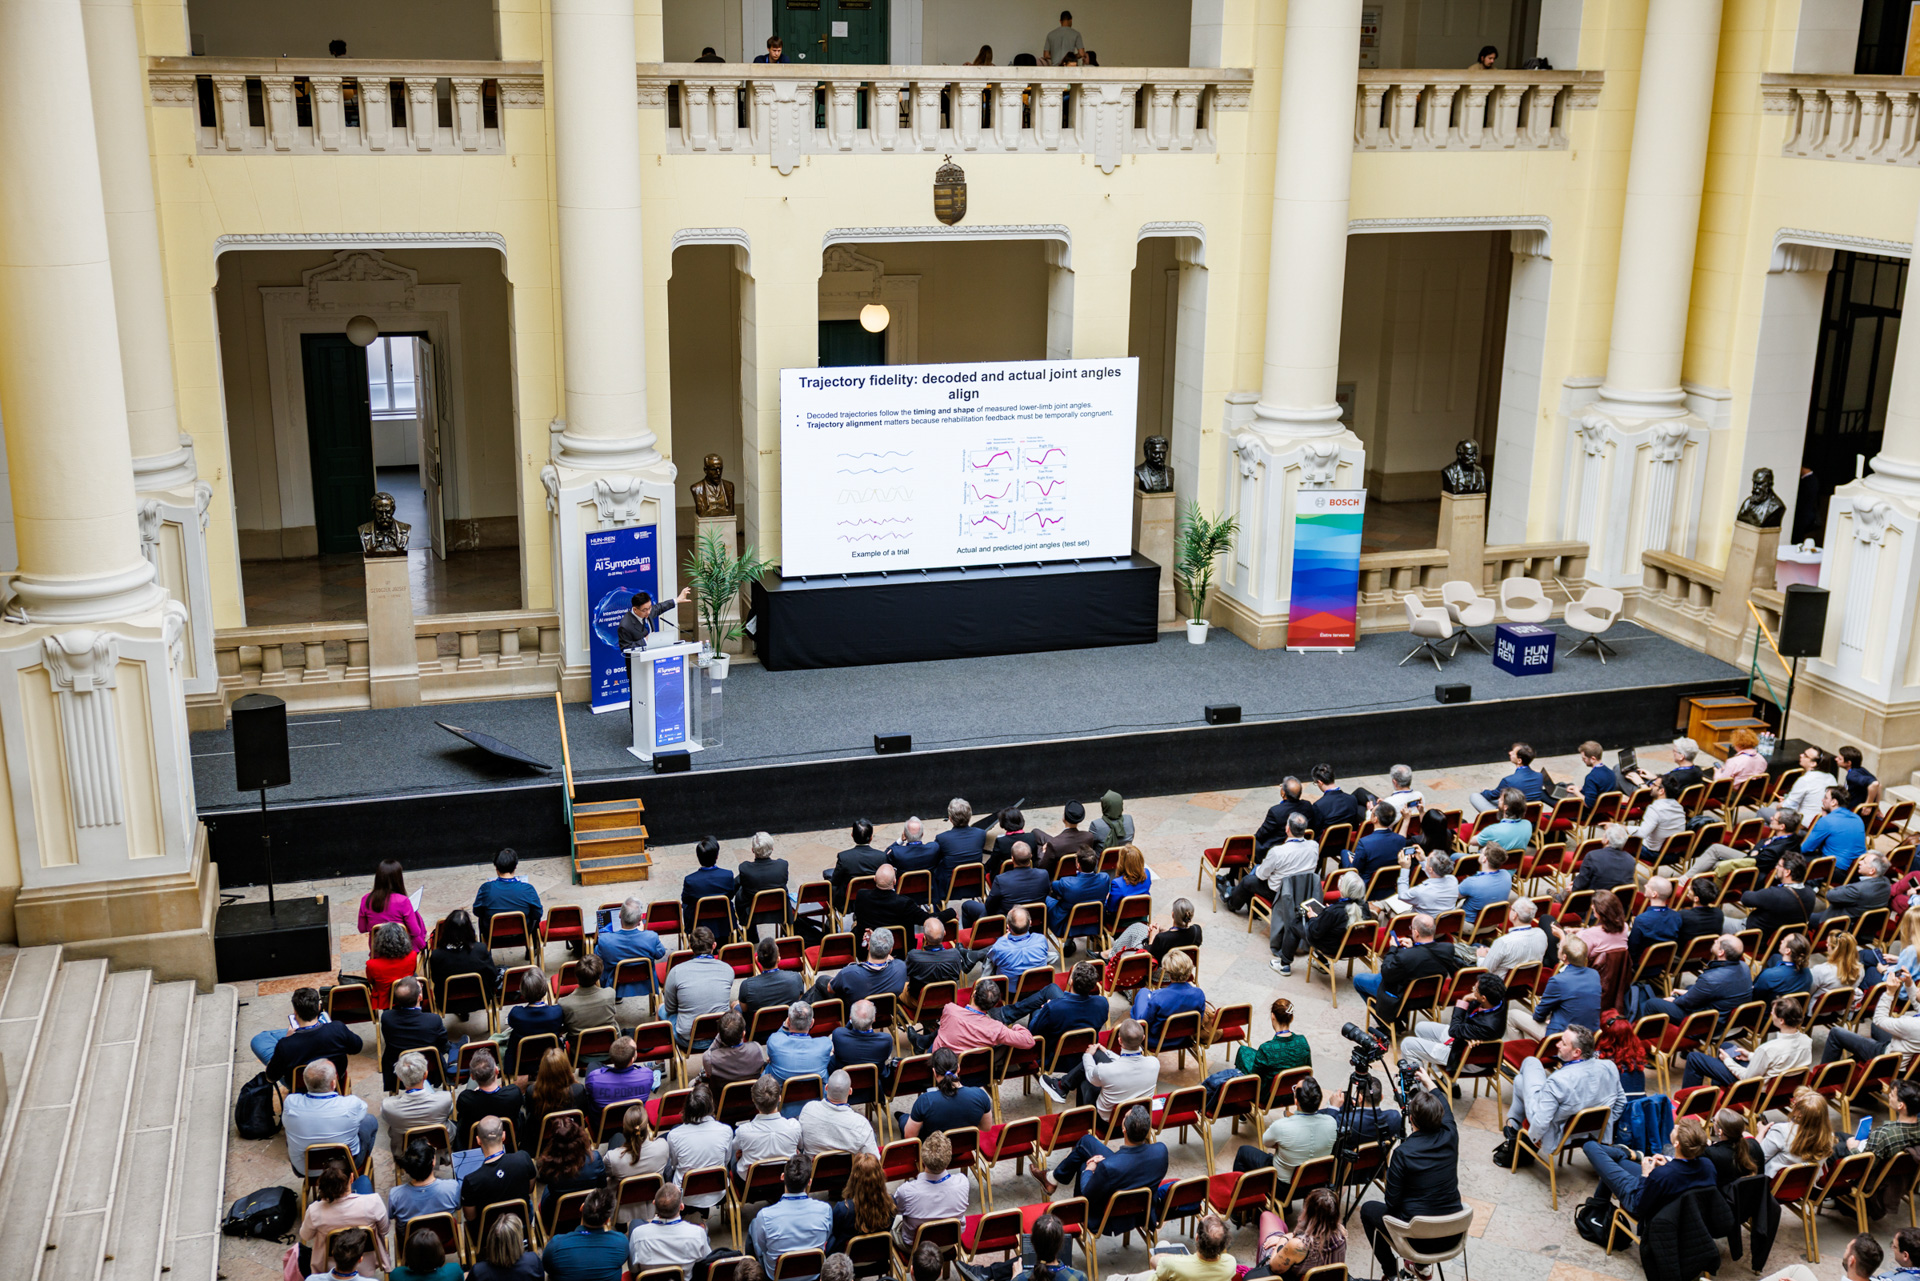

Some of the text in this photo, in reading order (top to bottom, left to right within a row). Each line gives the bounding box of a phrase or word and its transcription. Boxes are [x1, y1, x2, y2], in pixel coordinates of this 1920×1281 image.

[799, 367, 1121, 390] Trajectory fidelity: decoded and actual joint angles
[948, 388, 980, 401] align
[839, 410, 878, 419] trajectories
[913, 408, 936, 417] timing
[938, 407, 951, 415] and
[953, 406, 975, 415] shape
[976, 405, 984, 413] of
[984, 404, 1018, 412] measured
[1019, 403, 1053, 411] lower-limb
[1053, 402, 1068, 411] joint
[1069, 402, 1093, 410] angles.
[807, 421, 844, 430] Trajectory
[845, 419, 882, 428] alignment
[883, 418, 909, 426] matters
[911, 417, 939, 425] because
[941, 415, 984, 423] rehabilitation
[1044, 411, 1078, 420] temporally
[1080, 410, 1113, 418] congruent.
[1329, 498, 1360, 506] BOSCH
[956, 539, 1090, 554] Actual and predicted joint angles (test set)
[851, 550, 881, 559] Example
[594, 556, 651, 571] AI Symposium
[603, 608, 628, 616] International
[1498, 637, 1516, 655] HUN
[1524, 644, 1549, 656] HUN
[1497, 647, 1515, 664] REN
[1523, 654, 1548, 666] REN
[613, 665, 627, 673] BOSC
[614, 1085, 645, 1098] PORTO
